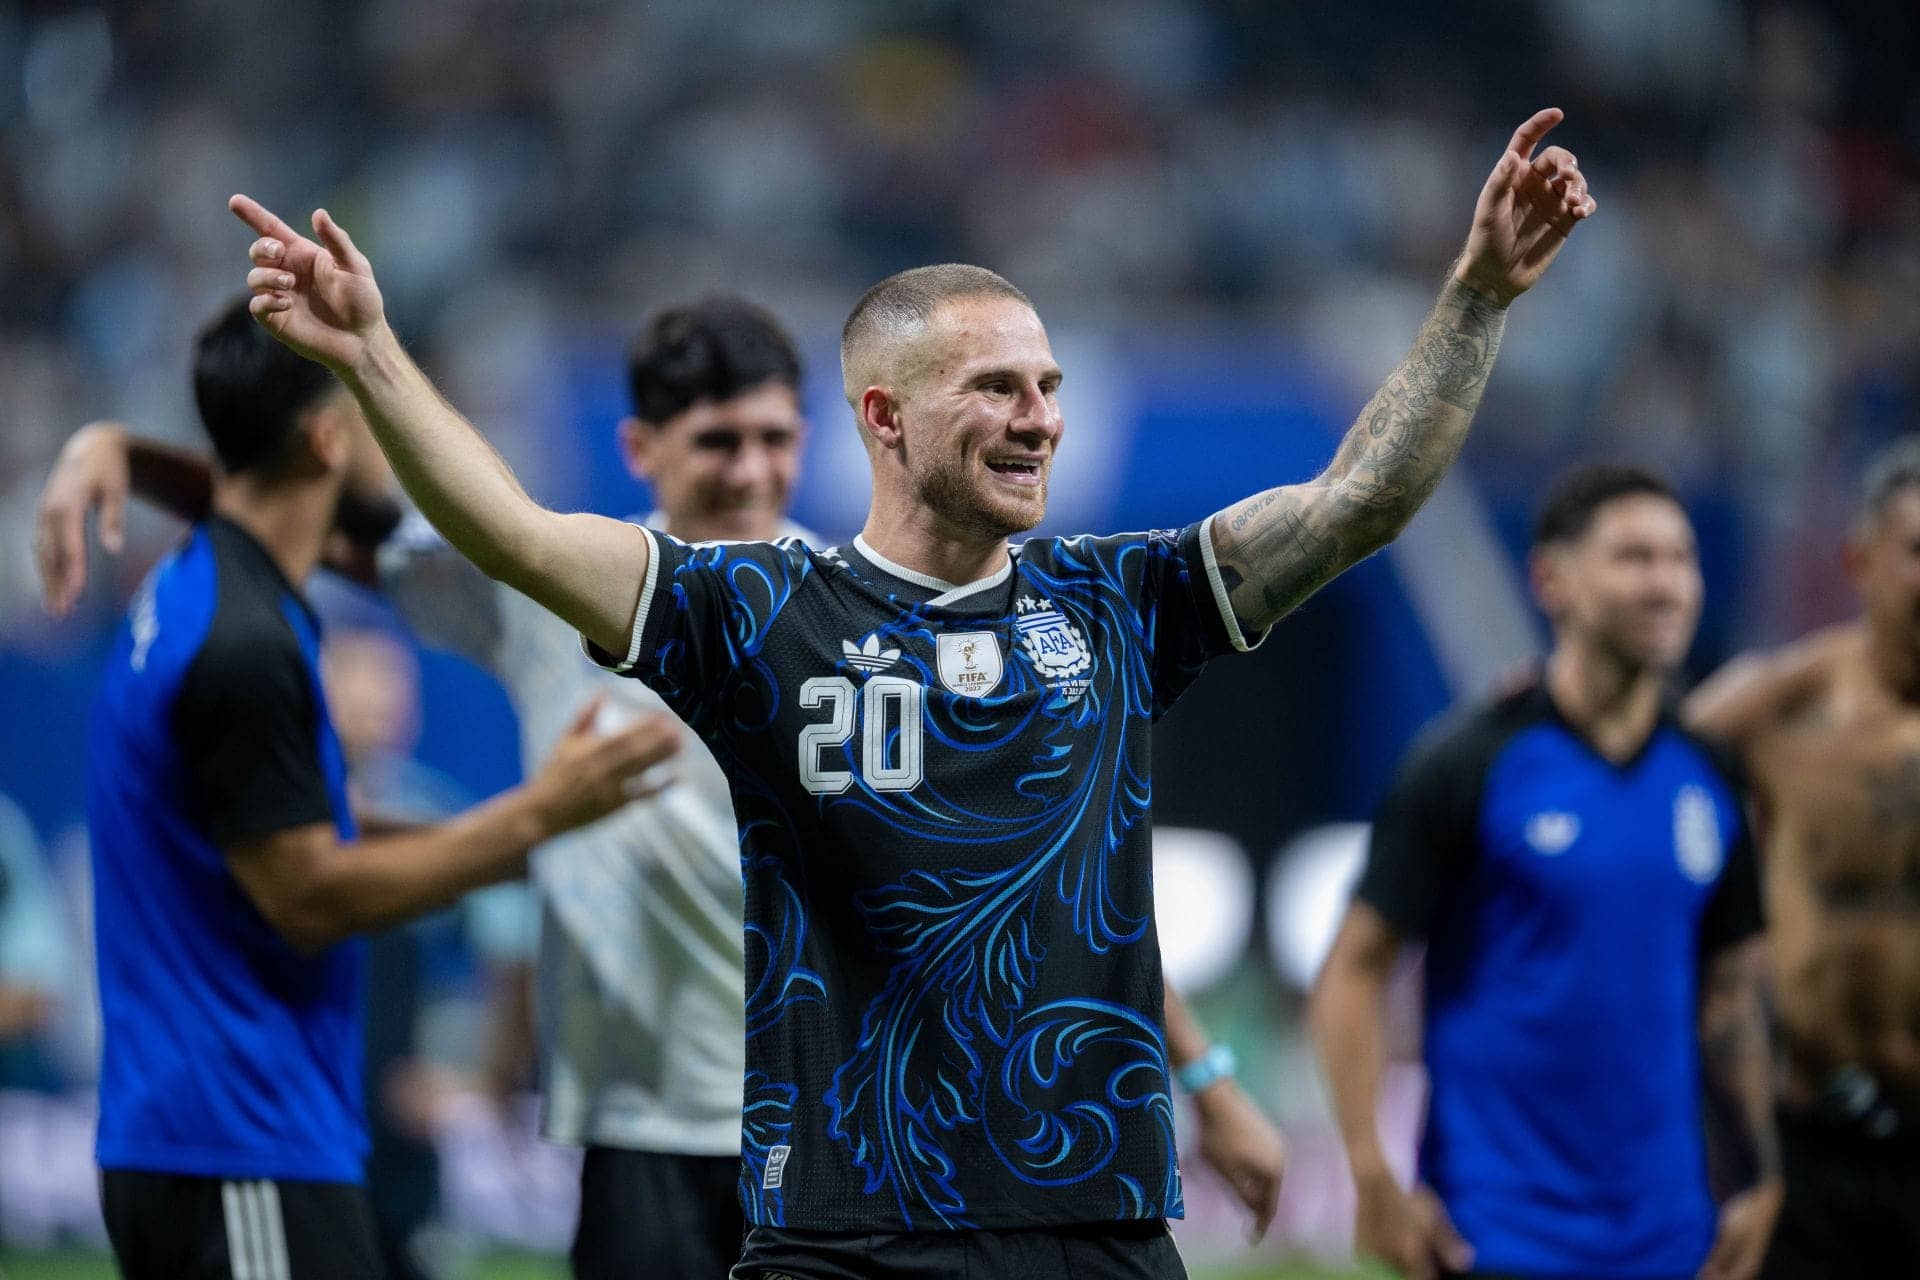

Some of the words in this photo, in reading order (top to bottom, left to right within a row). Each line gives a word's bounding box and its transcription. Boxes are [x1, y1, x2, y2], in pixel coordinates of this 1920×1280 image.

[1037, 627, 1075, 655] AFA
[958, 671, 986, 683] FIFA
[799, 675, 924, 795] 20
